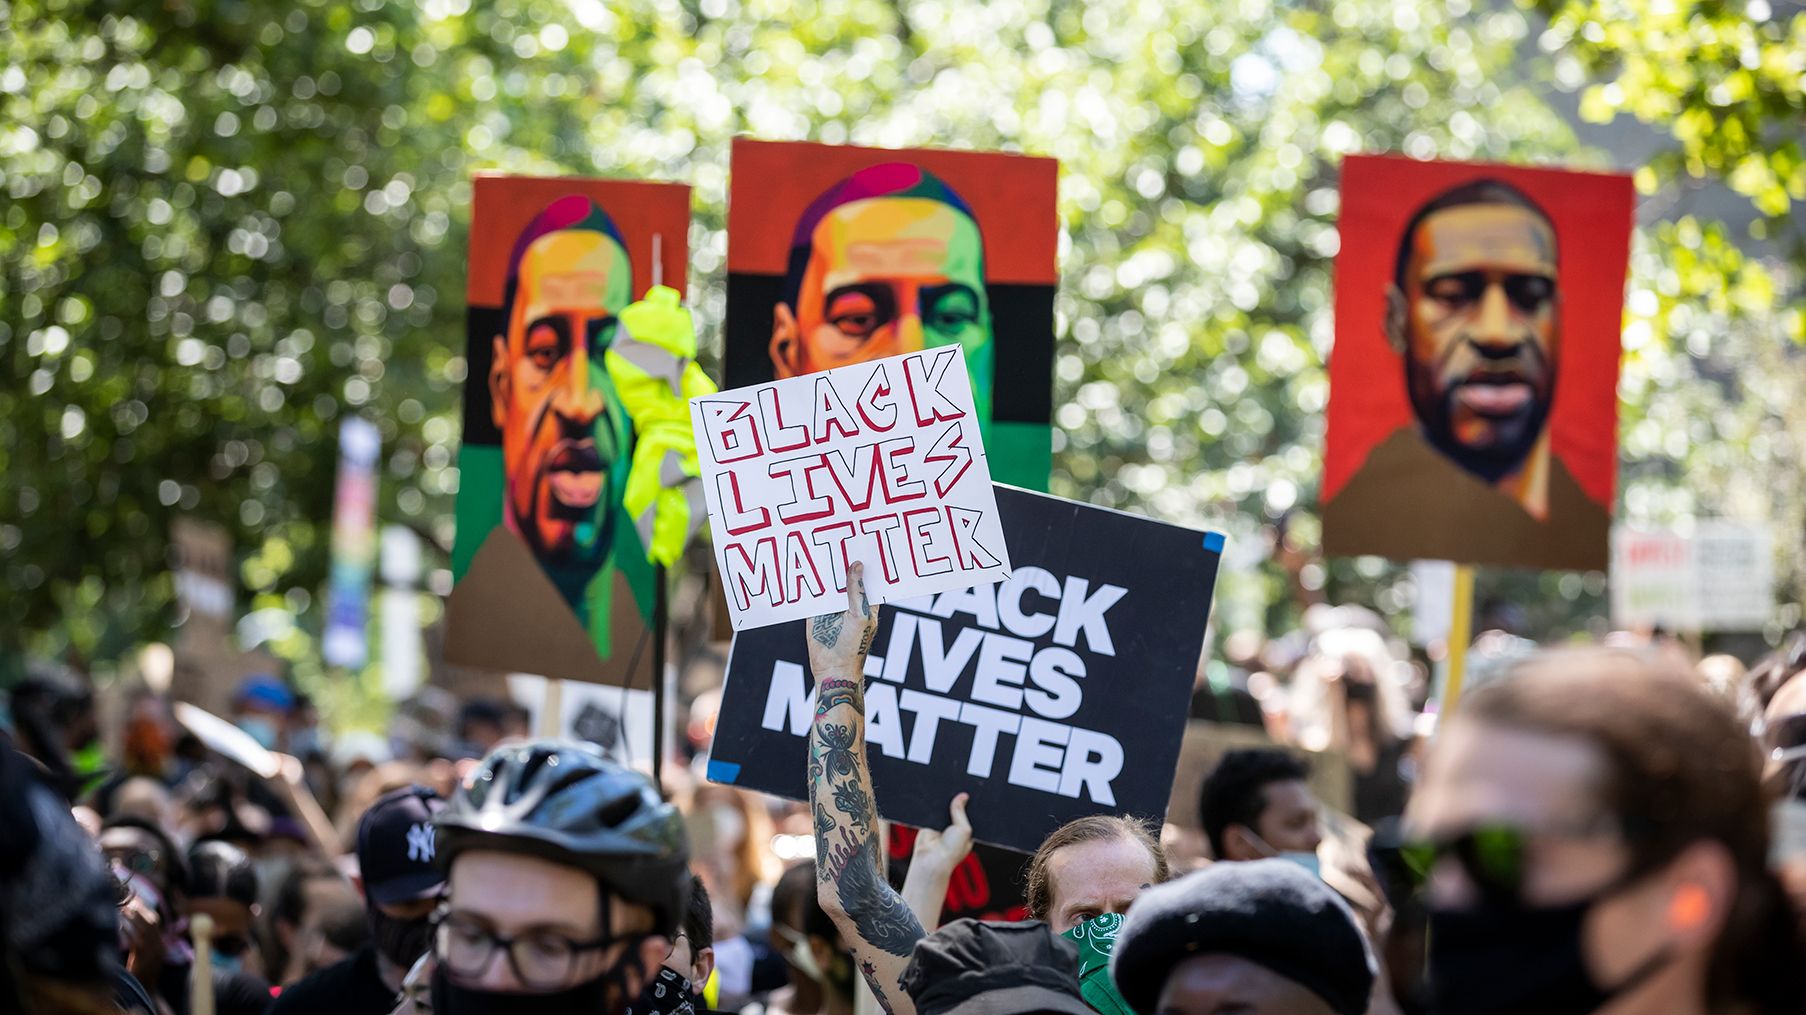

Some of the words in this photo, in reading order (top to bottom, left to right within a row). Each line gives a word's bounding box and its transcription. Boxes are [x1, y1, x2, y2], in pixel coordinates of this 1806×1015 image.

[700, 349, 967, 464] BLACK
[715, 421, 973, 536] LIVES
[723, 505, 1003, 612] MATTER
[883, 565, 1129, 657] ACK
